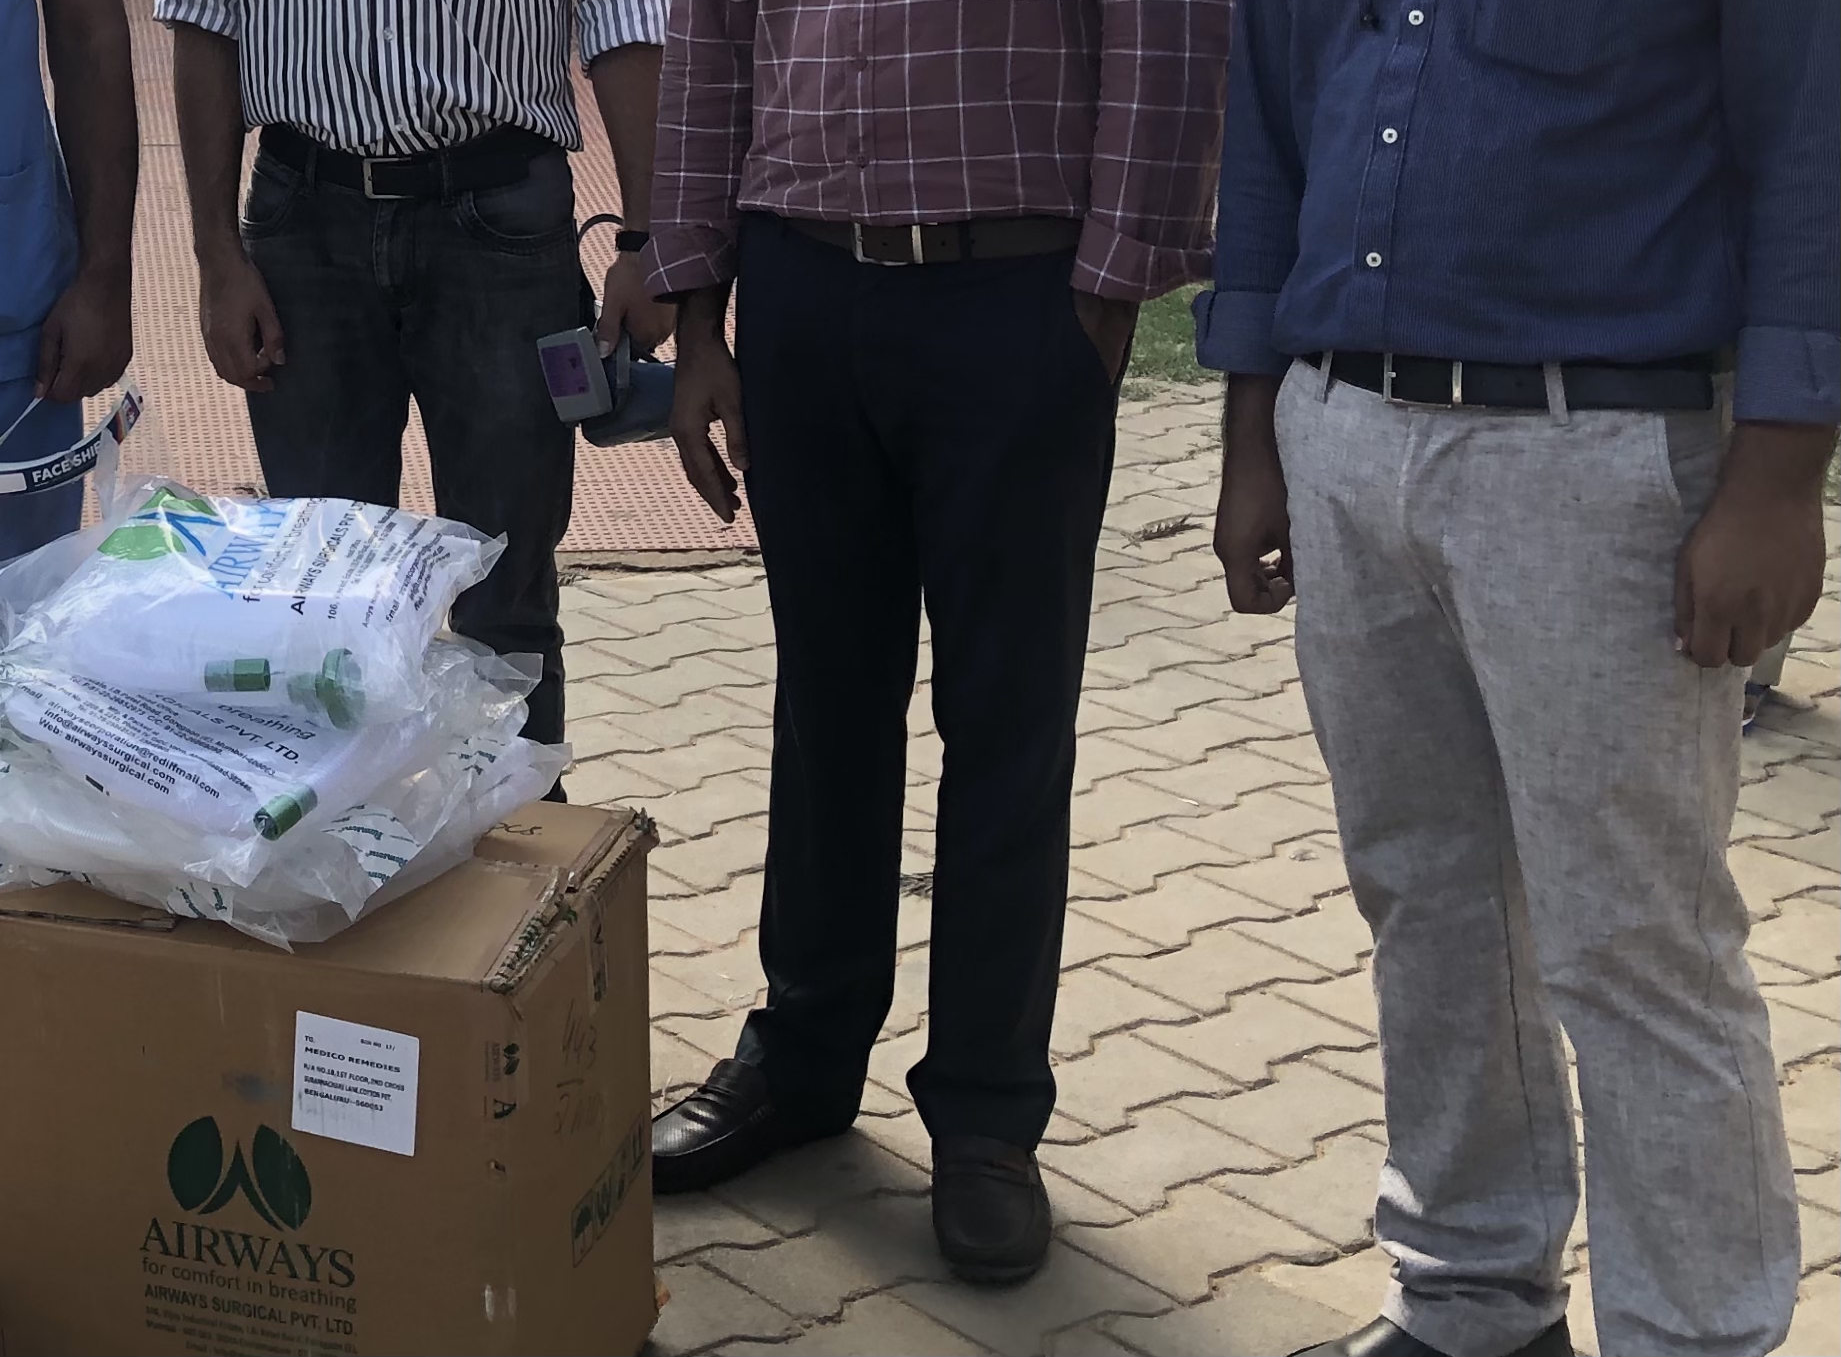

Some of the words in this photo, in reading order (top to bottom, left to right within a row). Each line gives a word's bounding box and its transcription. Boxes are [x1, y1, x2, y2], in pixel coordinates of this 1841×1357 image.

[32, 458, 71, 483] FACE
[264, 740, 300, 765] LTD.
[304, 1046, 346, 1061] MEDICO
[348, 1056, 401, 1073] REMEDIES
[139, 1217, 356, 1289] AIRWAYS
[142, 1256, 167, 1275] for
[172, 1266, 241, 1290] comfort
[247, 1278, 263, 1294] in
[269, 1280, 358, 1315] breathing
[144, 1283, 208, 1310] AIRWAYS
[211, 1298, 287, 1325] SURGICAL
[290, 1311, 322, 1331] PVT.
